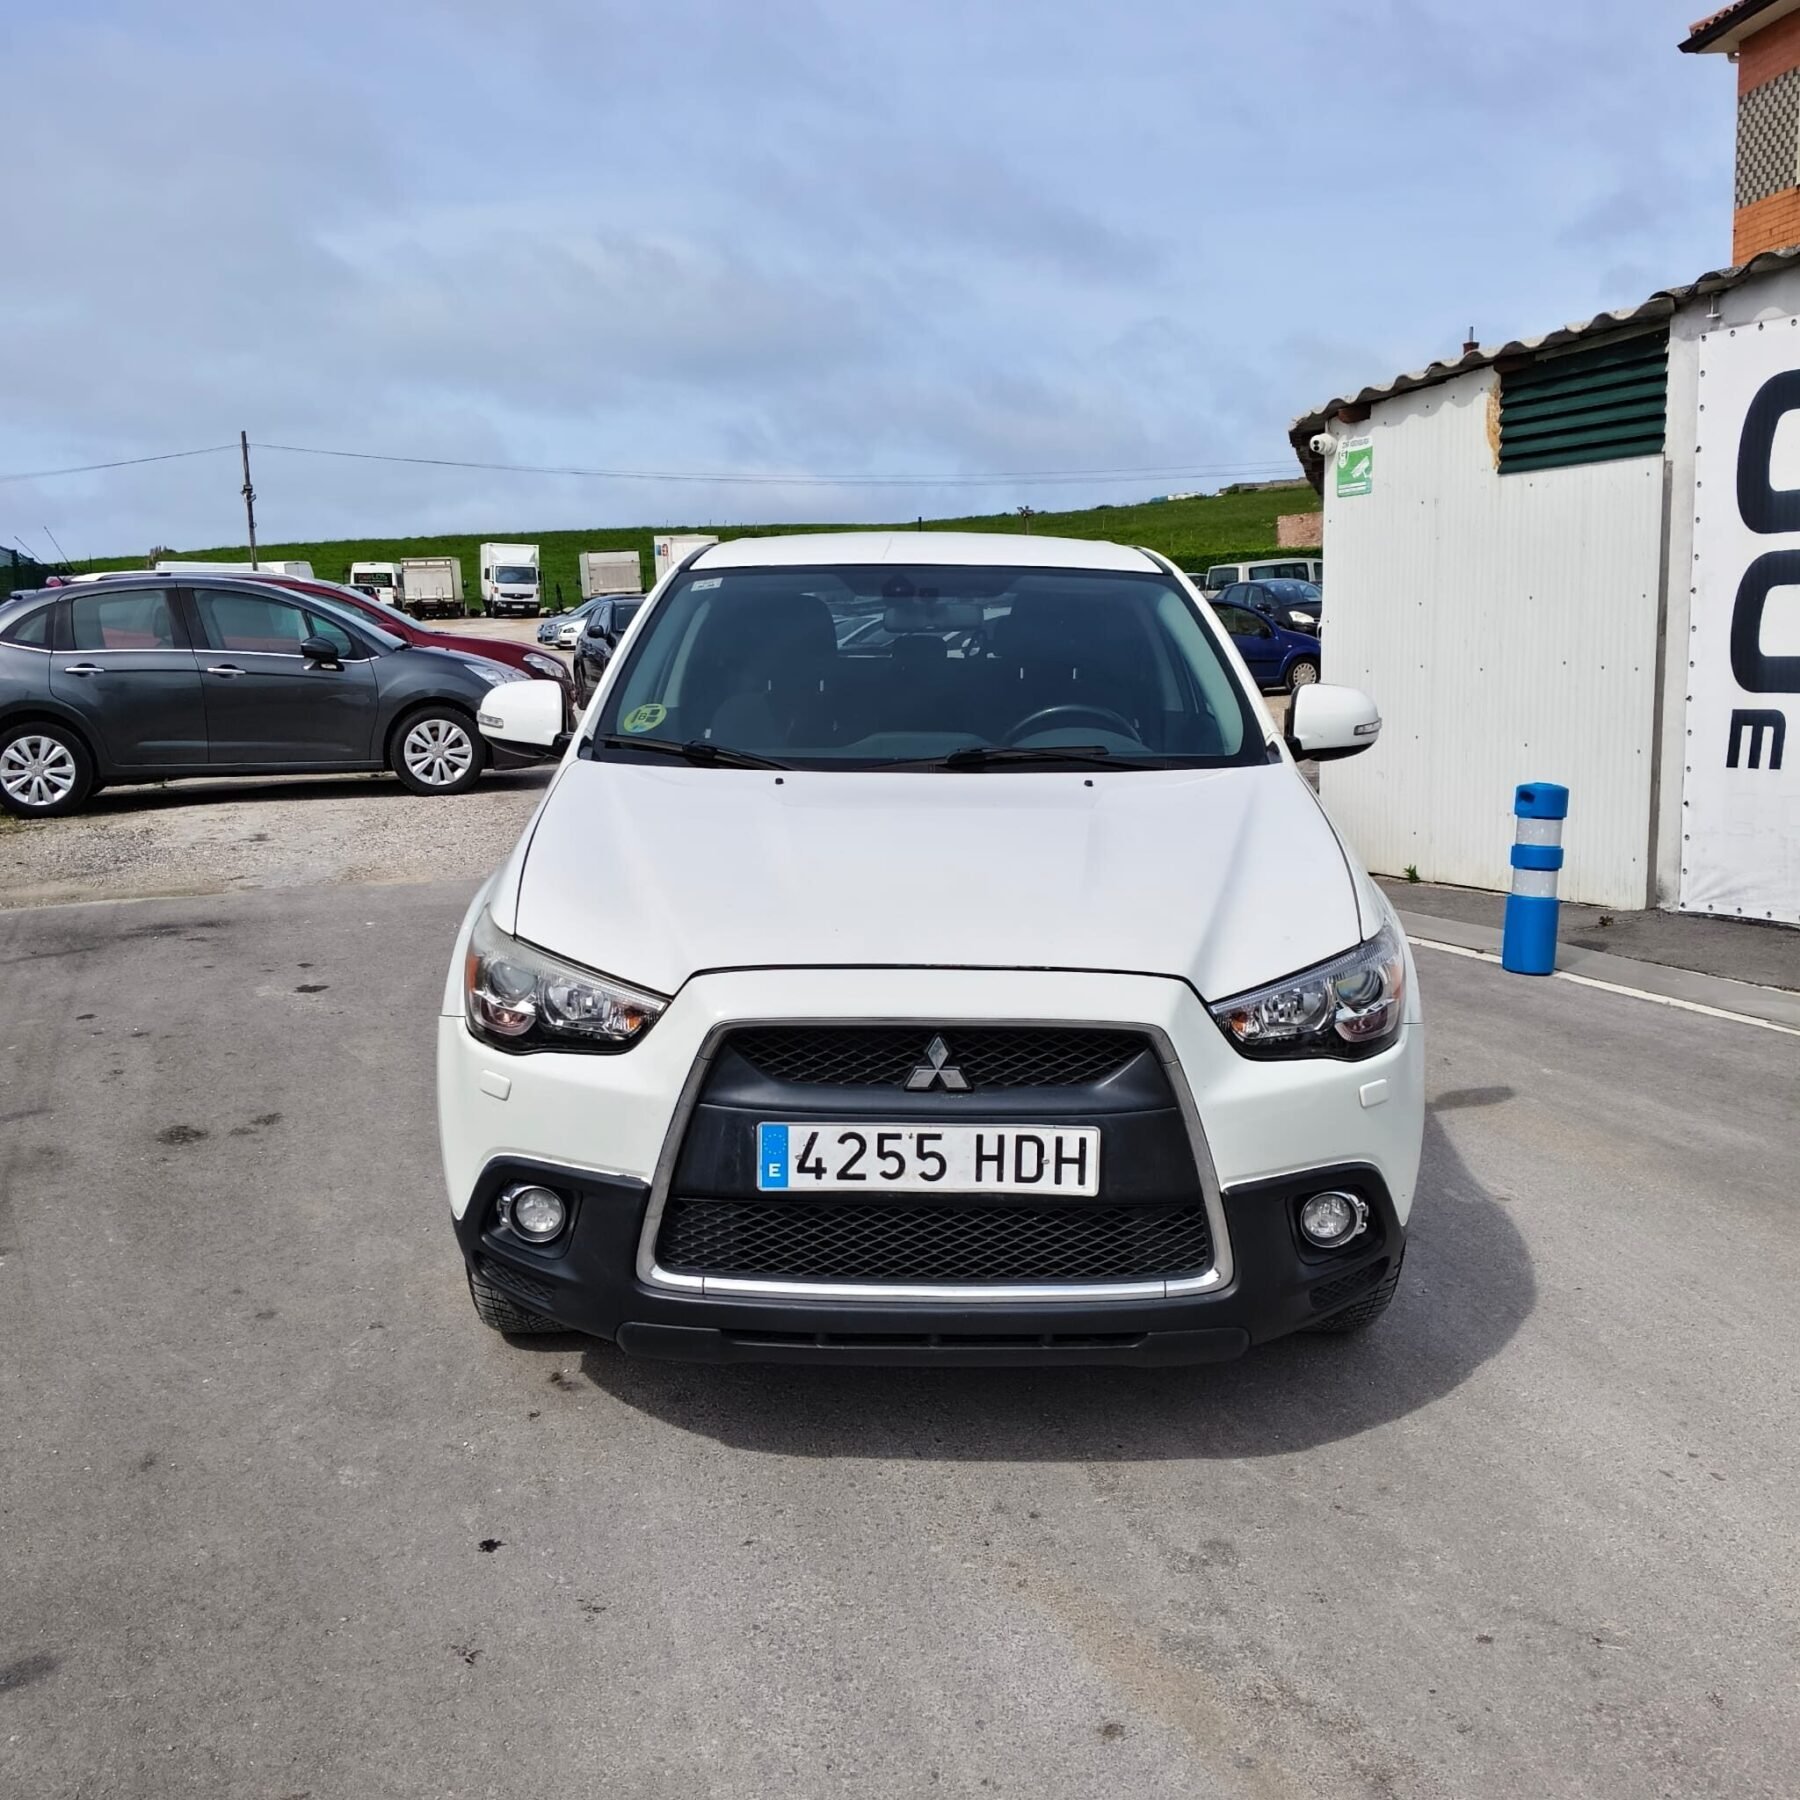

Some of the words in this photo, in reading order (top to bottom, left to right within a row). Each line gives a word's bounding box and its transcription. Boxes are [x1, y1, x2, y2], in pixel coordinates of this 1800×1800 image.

[768, 1163, 781, 1177] E
[796, 1131, 947, 1182] 4255
[975, 1134, 1087, 1186] HDH
